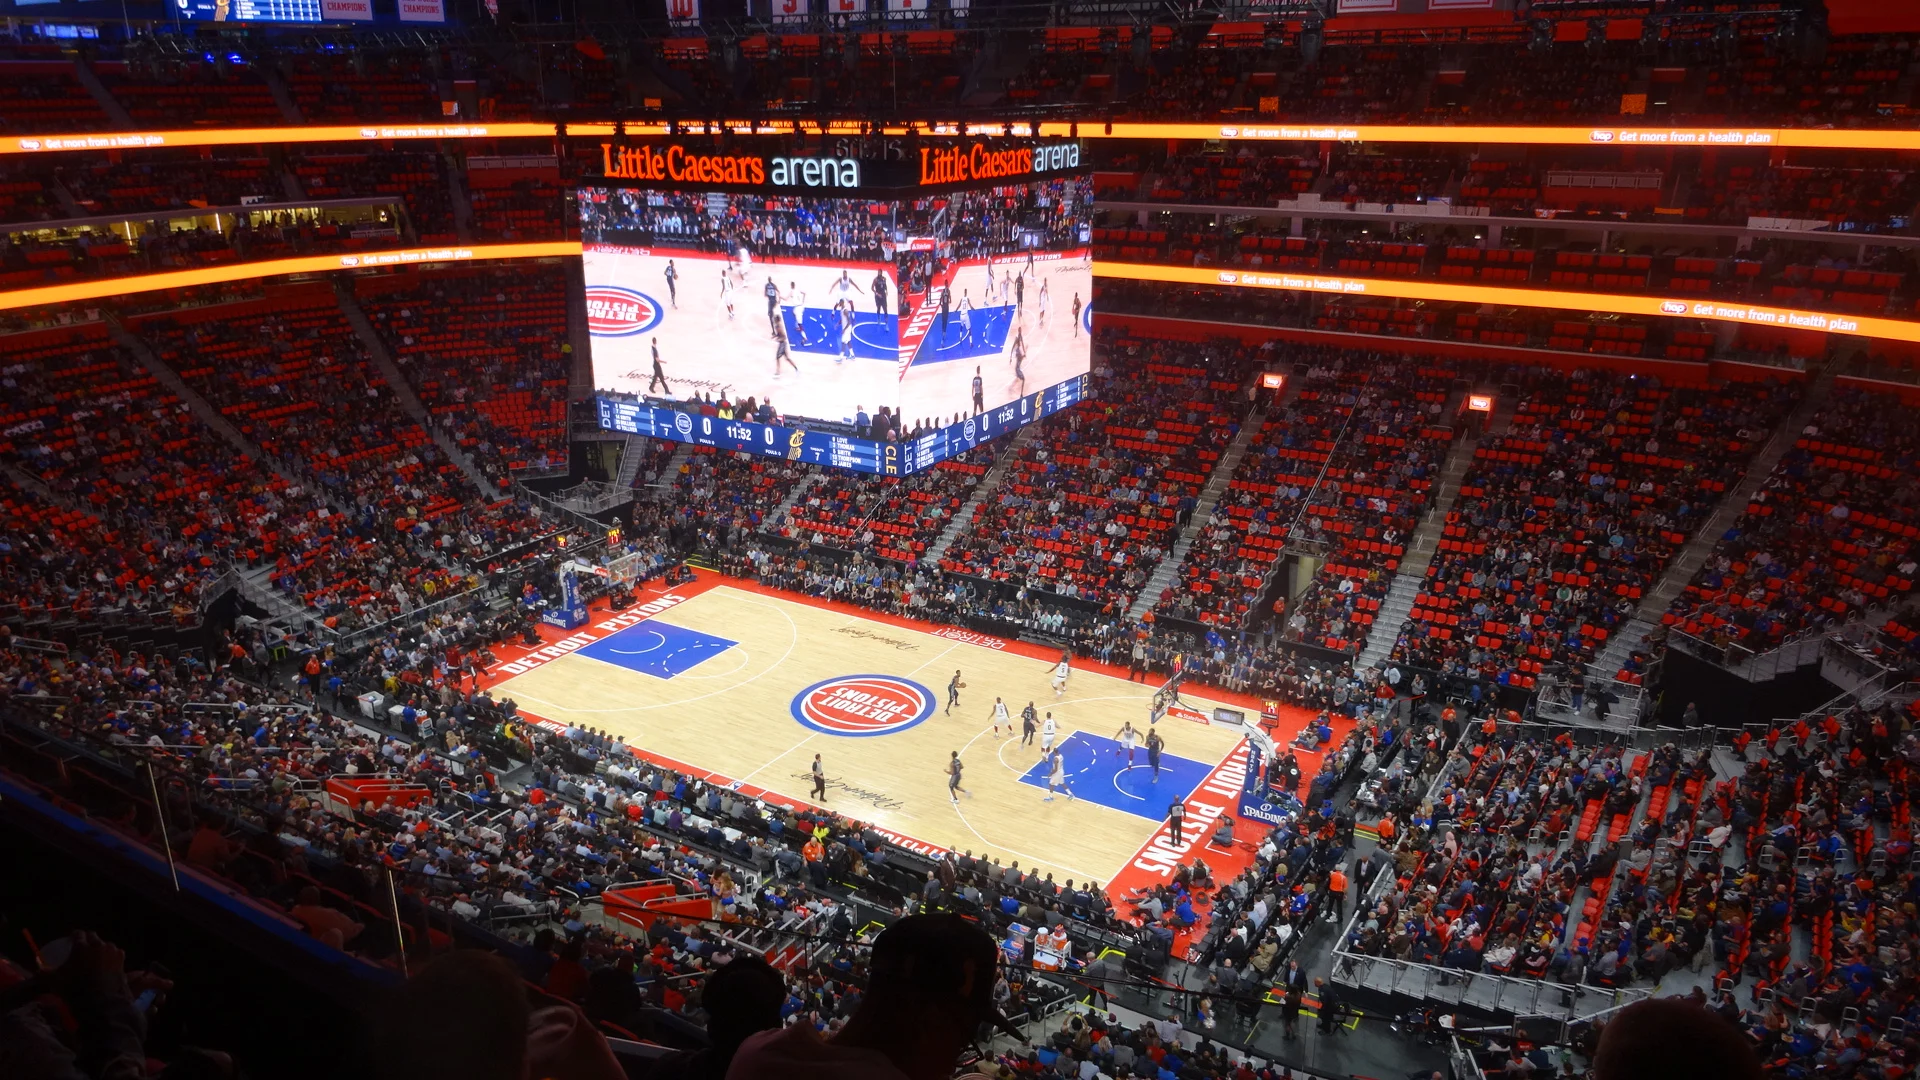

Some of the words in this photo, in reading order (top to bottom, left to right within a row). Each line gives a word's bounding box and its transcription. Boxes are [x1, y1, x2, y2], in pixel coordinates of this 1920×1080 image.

[327, 2, 367, 12] CHAMPIONS
[403, 4, 440, 14] CHAMPIONS
[46, 139, 62, 148] Get
[64, 139, 86, 148] more
[88, 138, 108, 146] from
[118, 136, 144, 146] health
[146, 136, 164, 146] plan
[1242, 128, 1256, 137] Get
[1281, 128, 1300, 138] from
[1310, 128, 1336, 138] health
[1338, 129, 1357, 140] plan
[1619, 131, 1636, 142] Get
[1640, 132, 1666, 142] more
[1670, 131, 1696, 142] from
[1698, 134, 1705, 142] a
[1708, 132, 1742, 142] health
[1745, 132, 1770, 144] plan
[601, 144, 665, 180] Little
[667, 145, 765, 184] Caesars
[771, 156, 858, 187] arena
[920, 146, 968, 186] Little
[970, 142, 1032, 180] Caesars
[1034, 142, 1079, 172] arena
[1242, 275, 1258, 284] Get
[1258, 278, 1281, 286] more
[1282, 277, 1304, 287] from
[1314, 280, 1342, 290] health
[1344, 282, 1364, 292] plan
[588, 309, 638, 322] DETRO
[1694, 304, 1713, 315] Get
[1716, 307, 1744, 318] more
[1748, 309, 1776, 322] from
[1778, 314, 1786, 323] a
[1788, 314, 1826, 328] health
[1829, 318, 1857, 331] plan
[600, 400, 612, 428] DET
[998, 408, 1014, 424] 11:52
[1022, 398, 1026, 416] 0
[664, 428, 669, 436] 7
[702, 418, 712, 435] 0
[983, 414, 988, 432] 0
[726, 426, 752, 440] 11:52
[764, 427, 774, 445] 0
[815, 452, 820, 461] 7
[838, 455, 862, 464] THOMPSON
[886, 446, 897, 474] CLE
[904, 444, 912, 474] DET
[498, 632, 598, 674] DETROIT
[594, 593, 686, 632] PISTONS
[930, 628, 1006, 650] DETROIT
[817, 696, 894, 722] DETROIT
[830, 688, 908, 714] PISTONS
[1183, 714, 1207, 724] StateFarm
[1244, 805, 1287, 825] SPALDING
[1134, 800, 1224, 876] PISTONS
